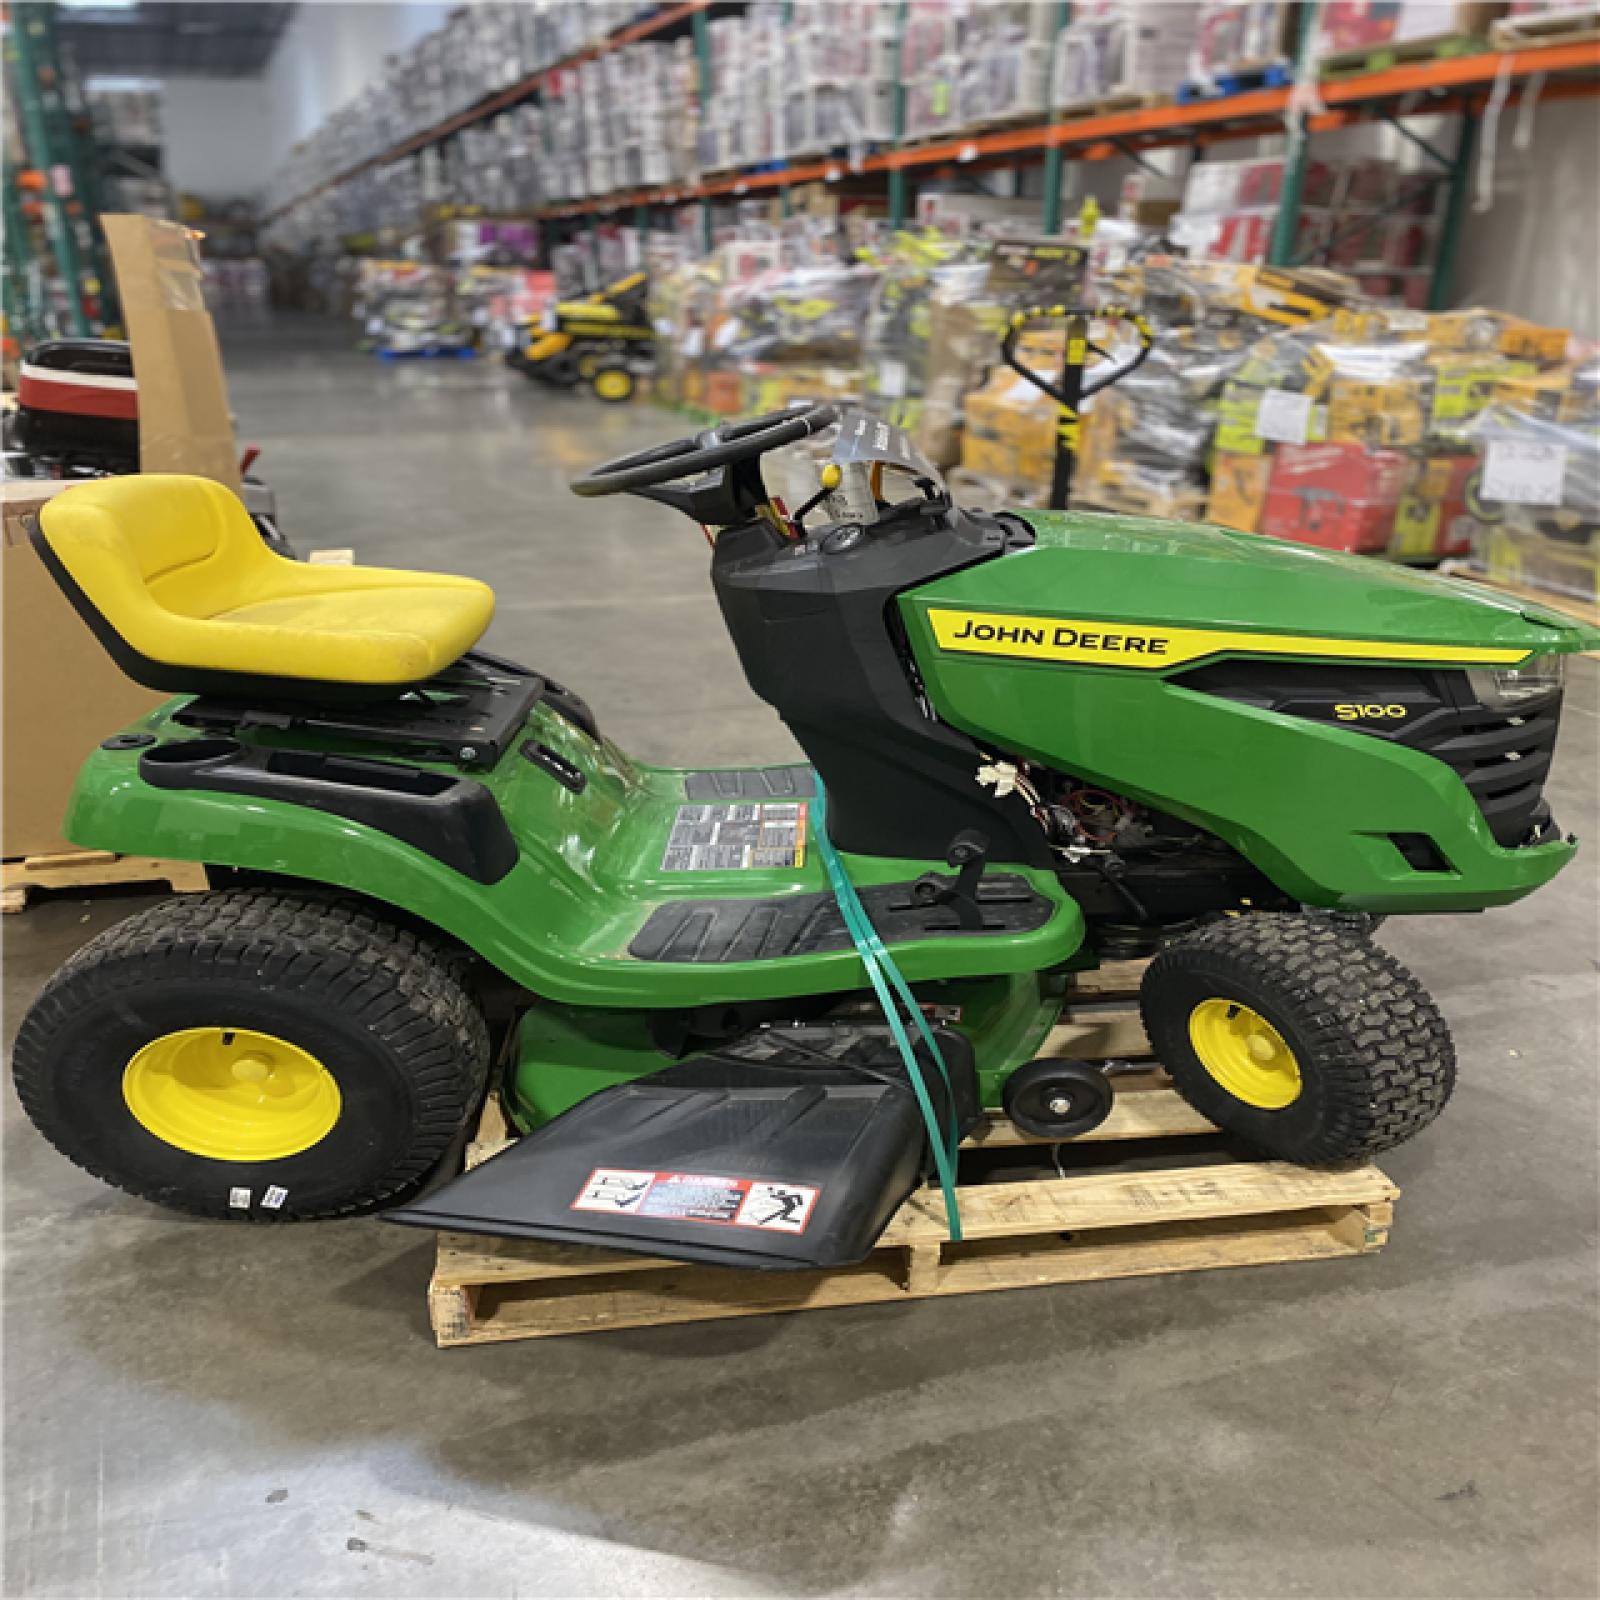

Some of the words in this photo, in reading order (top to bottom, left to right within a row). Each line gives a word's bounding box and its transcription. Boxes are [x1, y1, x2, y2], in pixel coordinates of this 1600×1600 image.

[954, 620, 1044, 645] JOHN
[1053, 627, 1168, 655] DEERE
[1335, 704, 1406, 720] S100
